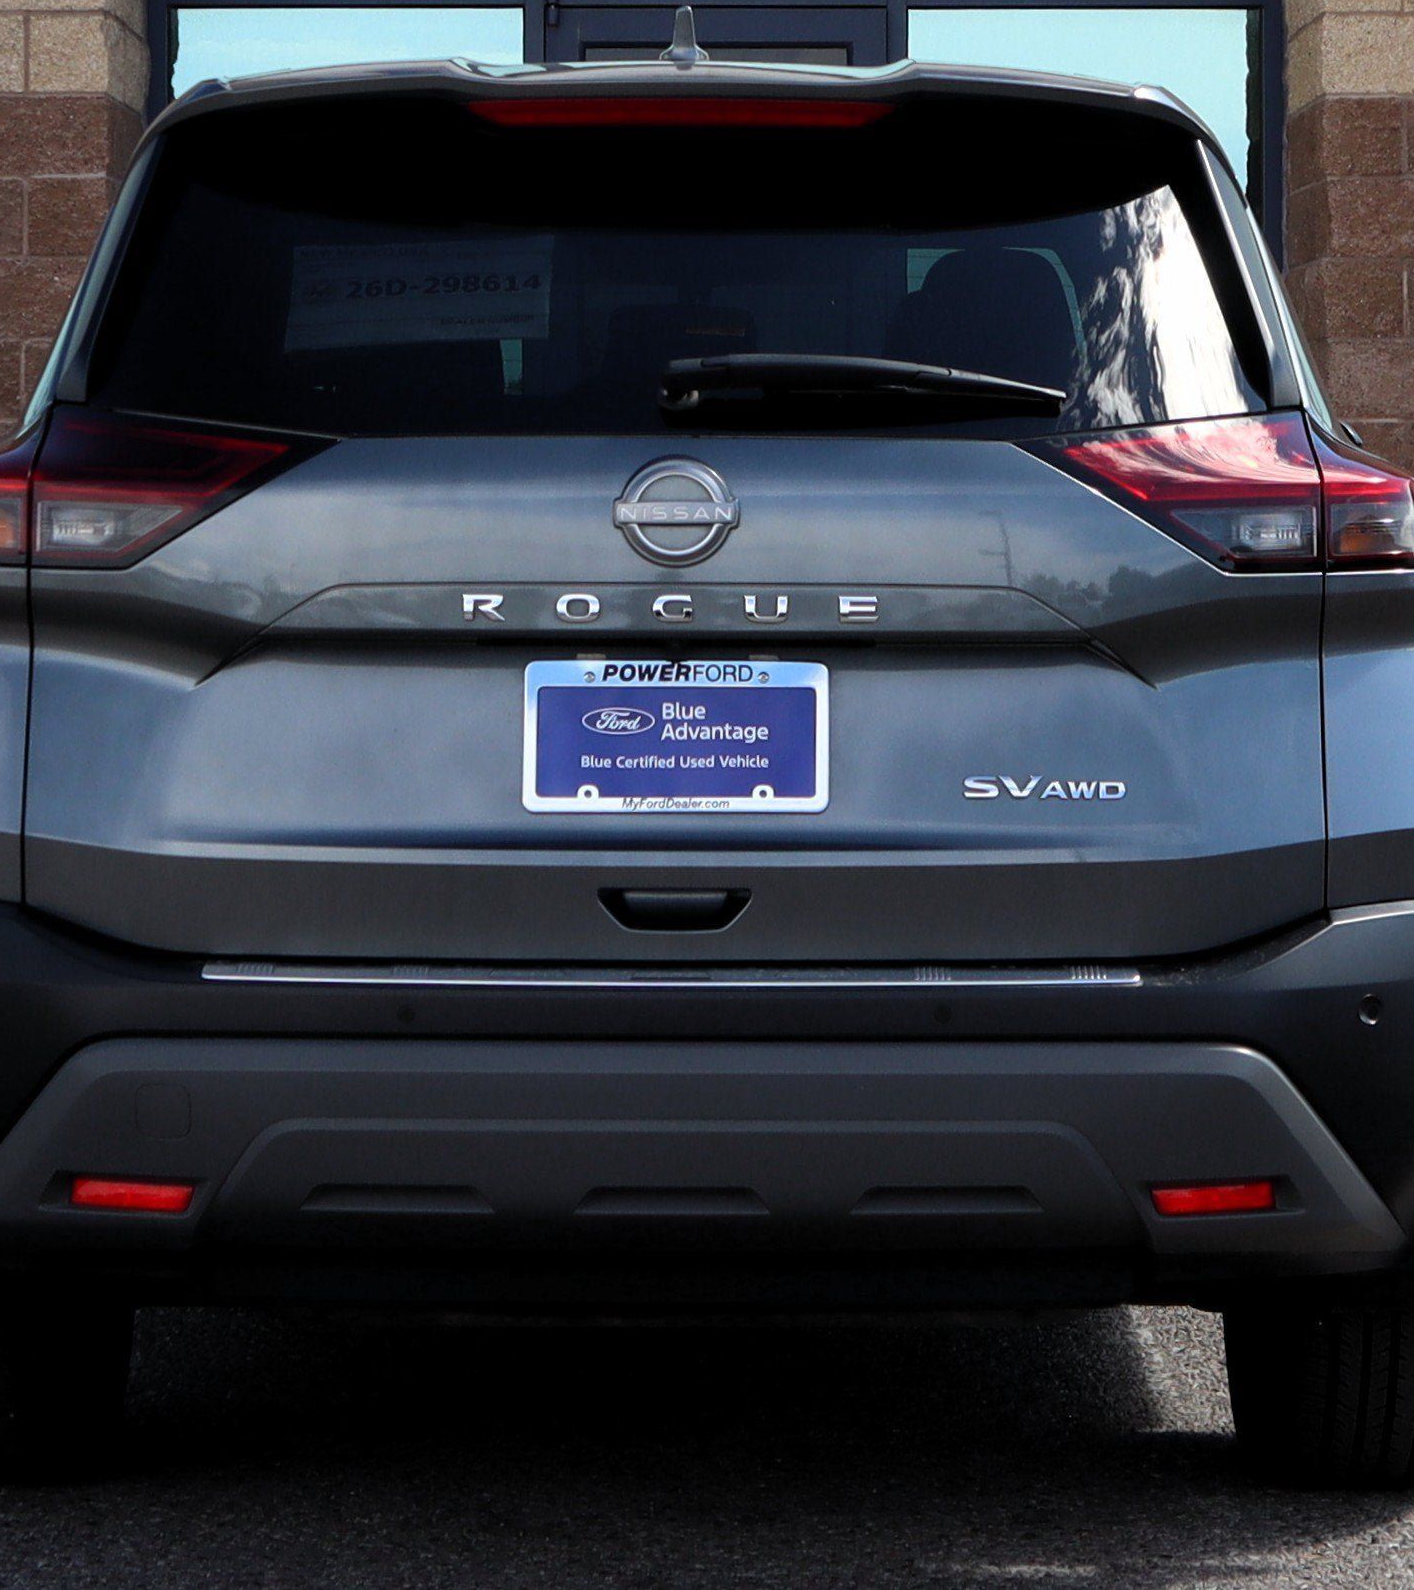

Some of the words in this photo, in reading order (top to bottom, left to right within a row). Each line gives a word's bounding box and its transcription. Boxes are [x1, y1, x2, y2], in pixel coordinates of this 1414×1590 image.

[345, 273, 543, 299] 26D-298614
[619, 506, 732, 521] NISSAN
[462, 593, 880, 622] ROGUE
[595, 710, 642, 731] Ford
[661, 701, 706, 720] Blue
[660, 722, 769, 744] Advantage
[580, 754, 612, 769] Blue
[615, 754, 675, 769] Certified
[679, 754, 715, 769] Used
[718, 754, 769, 769] Vehicle
[962, 774, 1043, 799] SV
[1040, 781, 1127, 799] AWD
[621, 796, 730, 812] MyFordDealer.com
